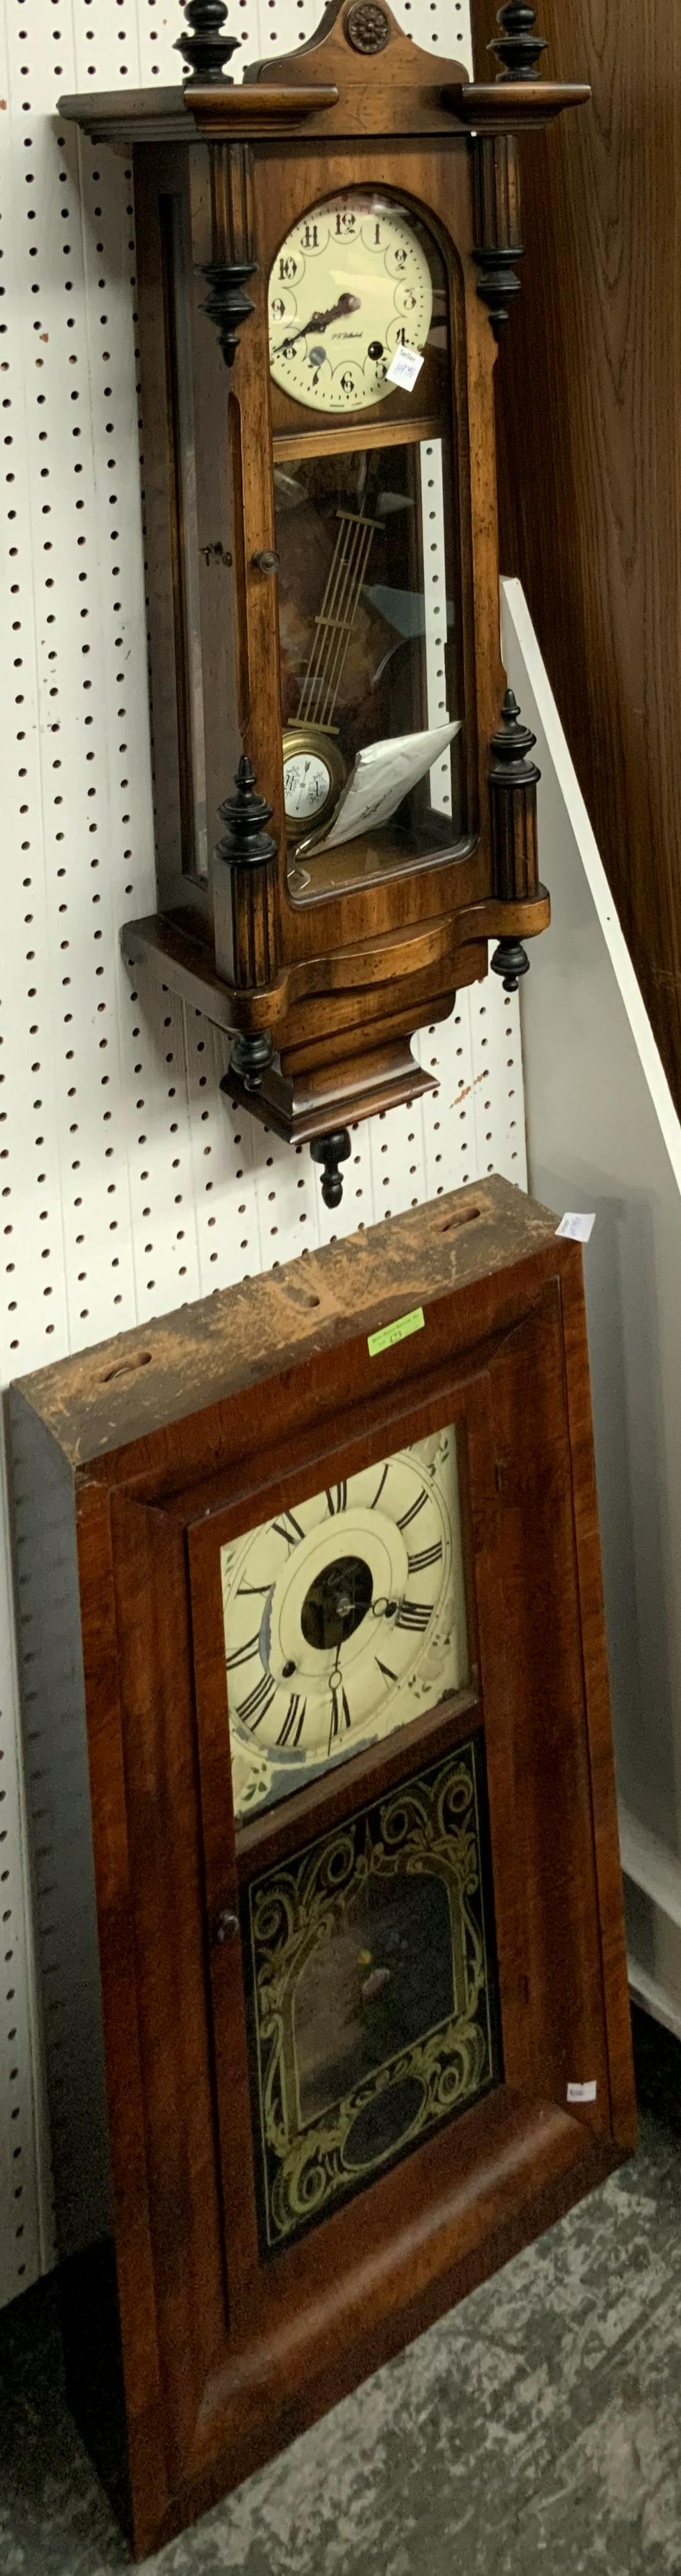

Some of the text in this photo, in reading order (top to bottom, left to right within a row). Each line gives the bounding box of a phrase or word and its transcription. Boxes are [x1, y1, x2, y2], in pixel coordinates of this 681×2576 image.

[335, 213, 356, 235] 12
[374, 223, 380, 245] 1
[301, 225, 319, 250] 11
[278, 256, 297, 280] 10
[395, 249, 407, 272] 2
[271, 298, 286, 321] 9
[404, 288, 417, 310] 3
[395, 327, 408, 347] 4
[399, 349, 416, 362] Seller
[340, 371, 354, 393] 6
[407, 1541, 442, 1574] III
